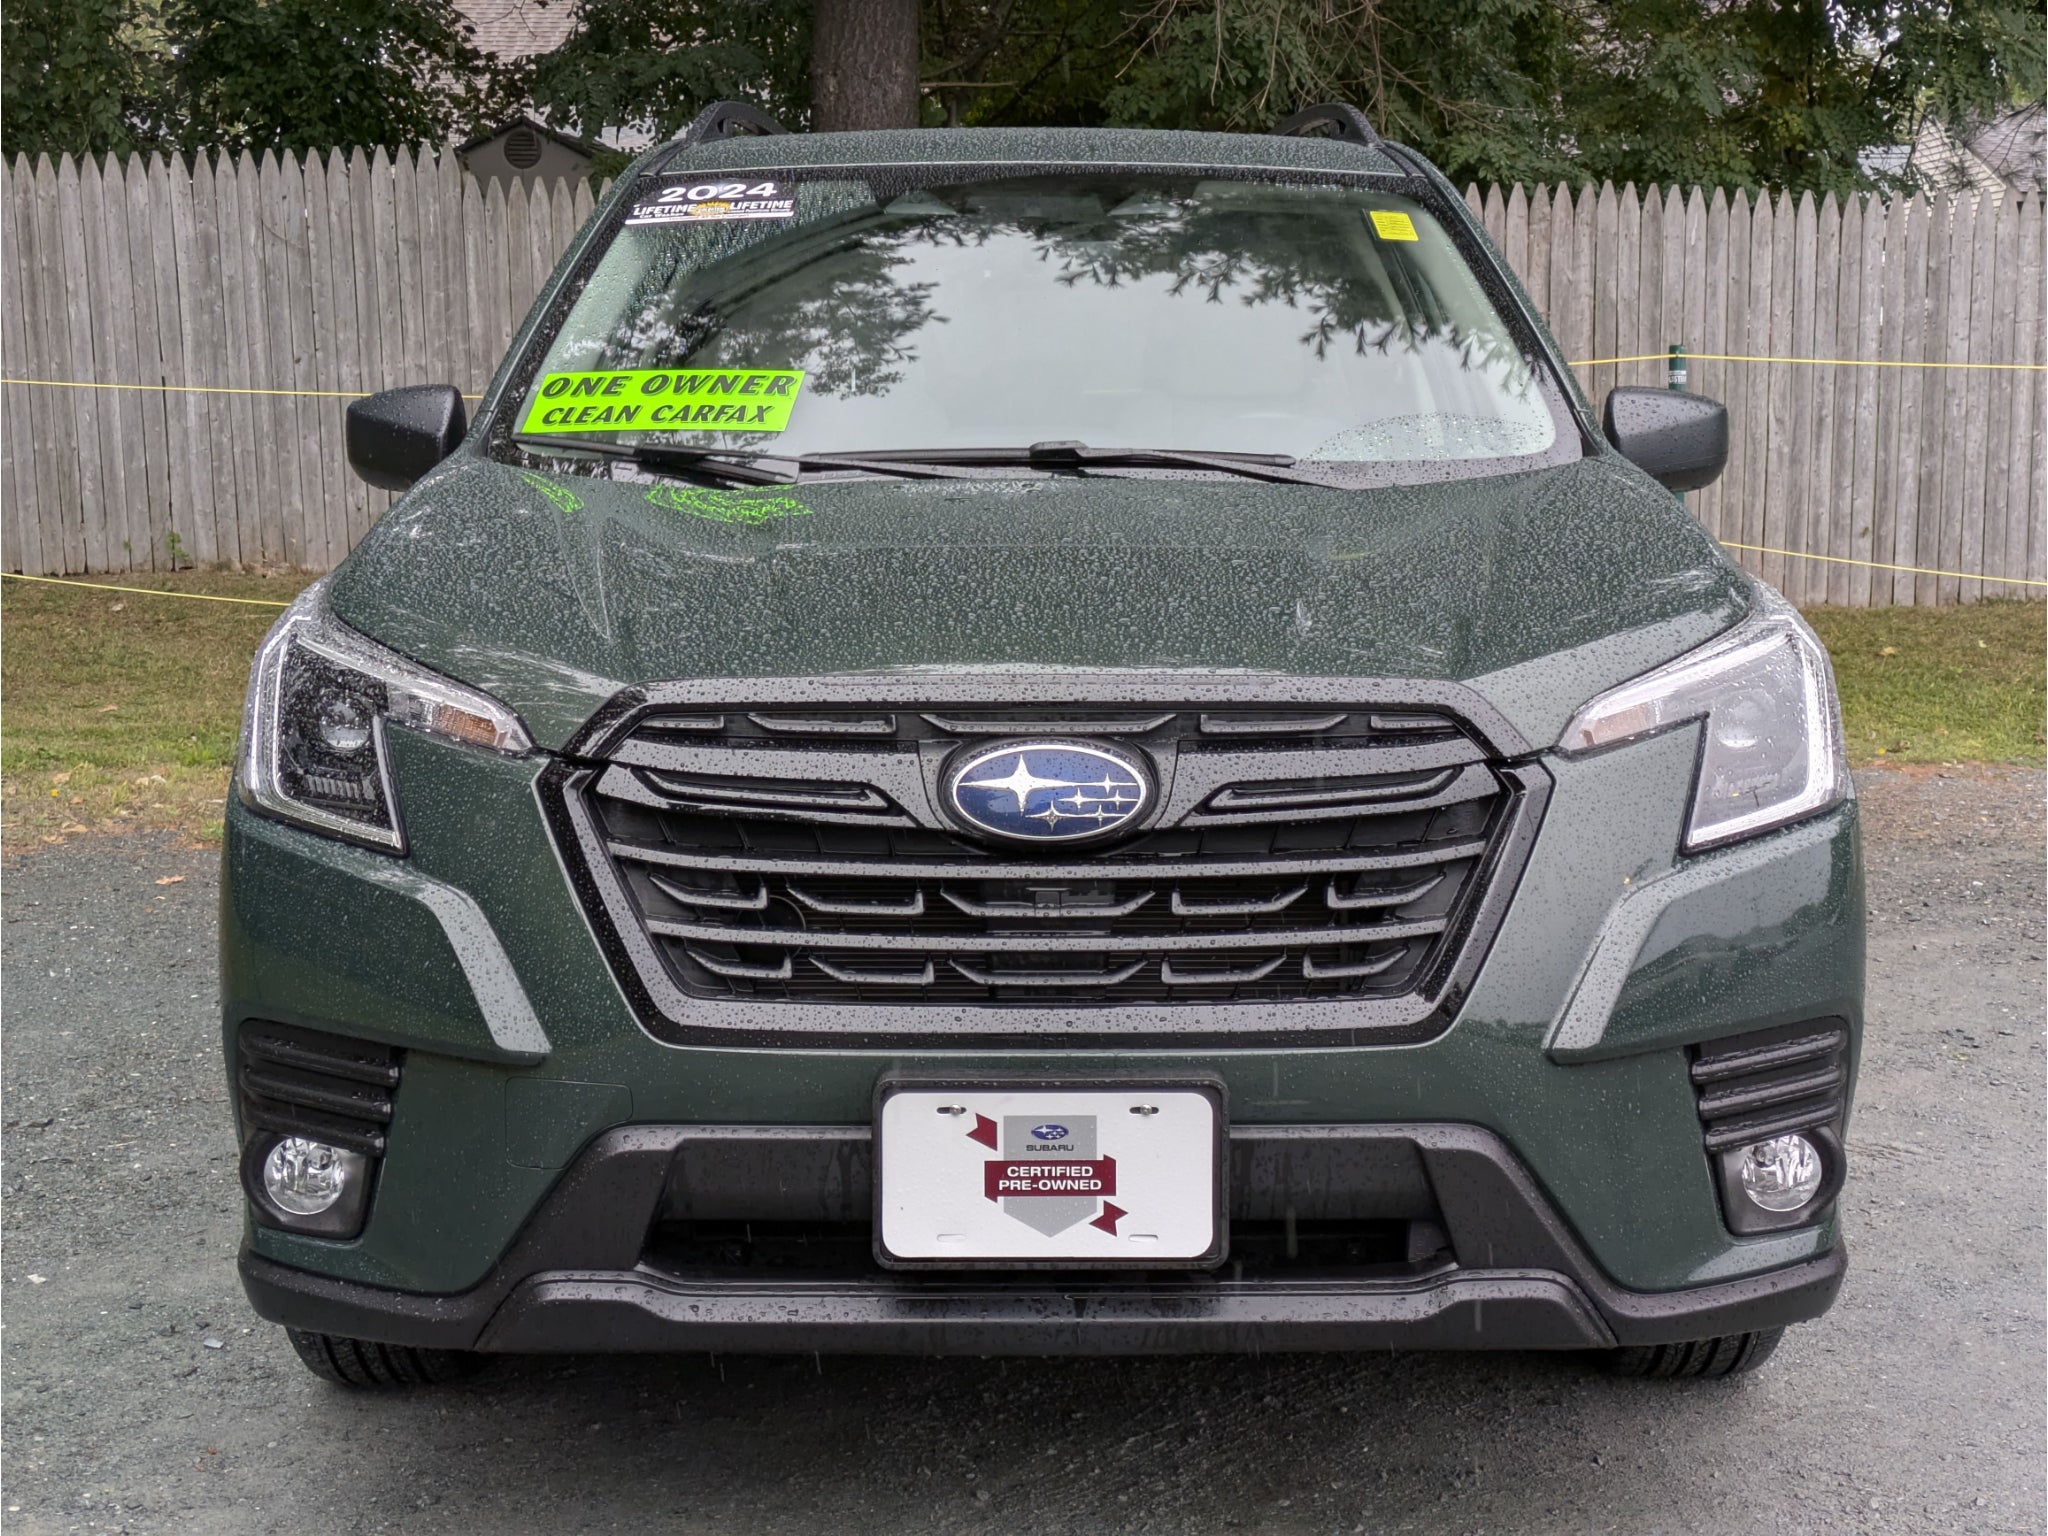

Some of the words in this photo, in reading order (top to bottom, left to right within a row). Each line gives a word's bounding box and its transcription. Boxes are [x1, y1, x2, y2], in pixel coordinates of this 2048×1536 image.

[658, 183, 777, 202] 2024
[633, 204, 697, 215] LIFETIME
[730, 200, 793, 210] LIFETIME
[542, 375, 632, 397] ONE
[641, 374, 797, 397] OWNER
[542, 405, 642, 425] CLEAN
[650, 404, 774, 424] CARFAX
[1006, 1166, 1093, 1177] CERTIFIED
[998, 1179, 1102, 1191] PRE-OWNED
